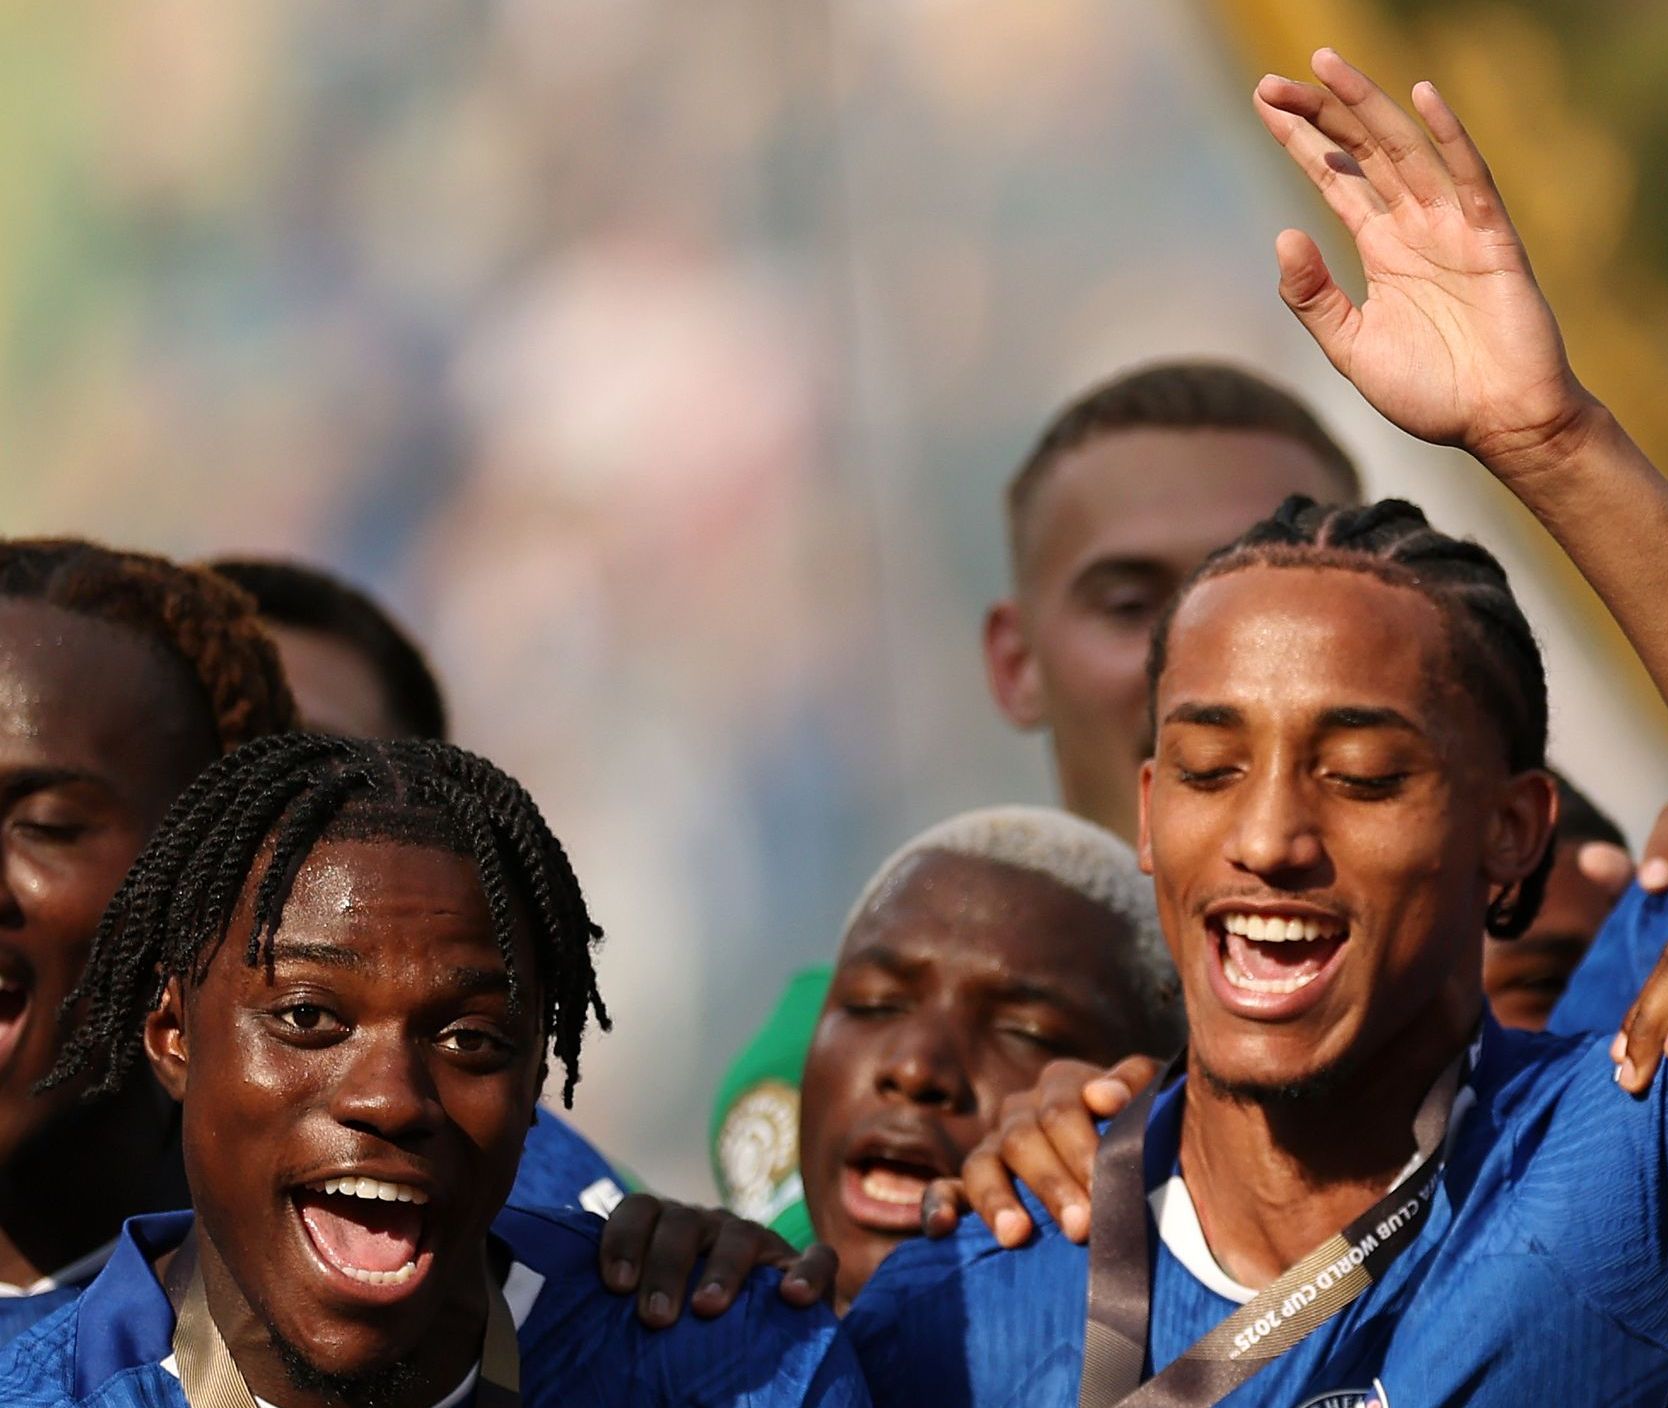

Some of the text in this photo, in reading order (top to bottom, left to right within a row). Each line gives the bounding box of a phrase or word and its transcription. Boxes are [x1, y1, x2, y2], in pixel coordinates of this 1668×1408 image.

[1376, 1200, 1419, 1239] CLUB
[1317, 1233, 1379, 1290] WORLD
[1280, 1285, 1318, 1318] CUP
